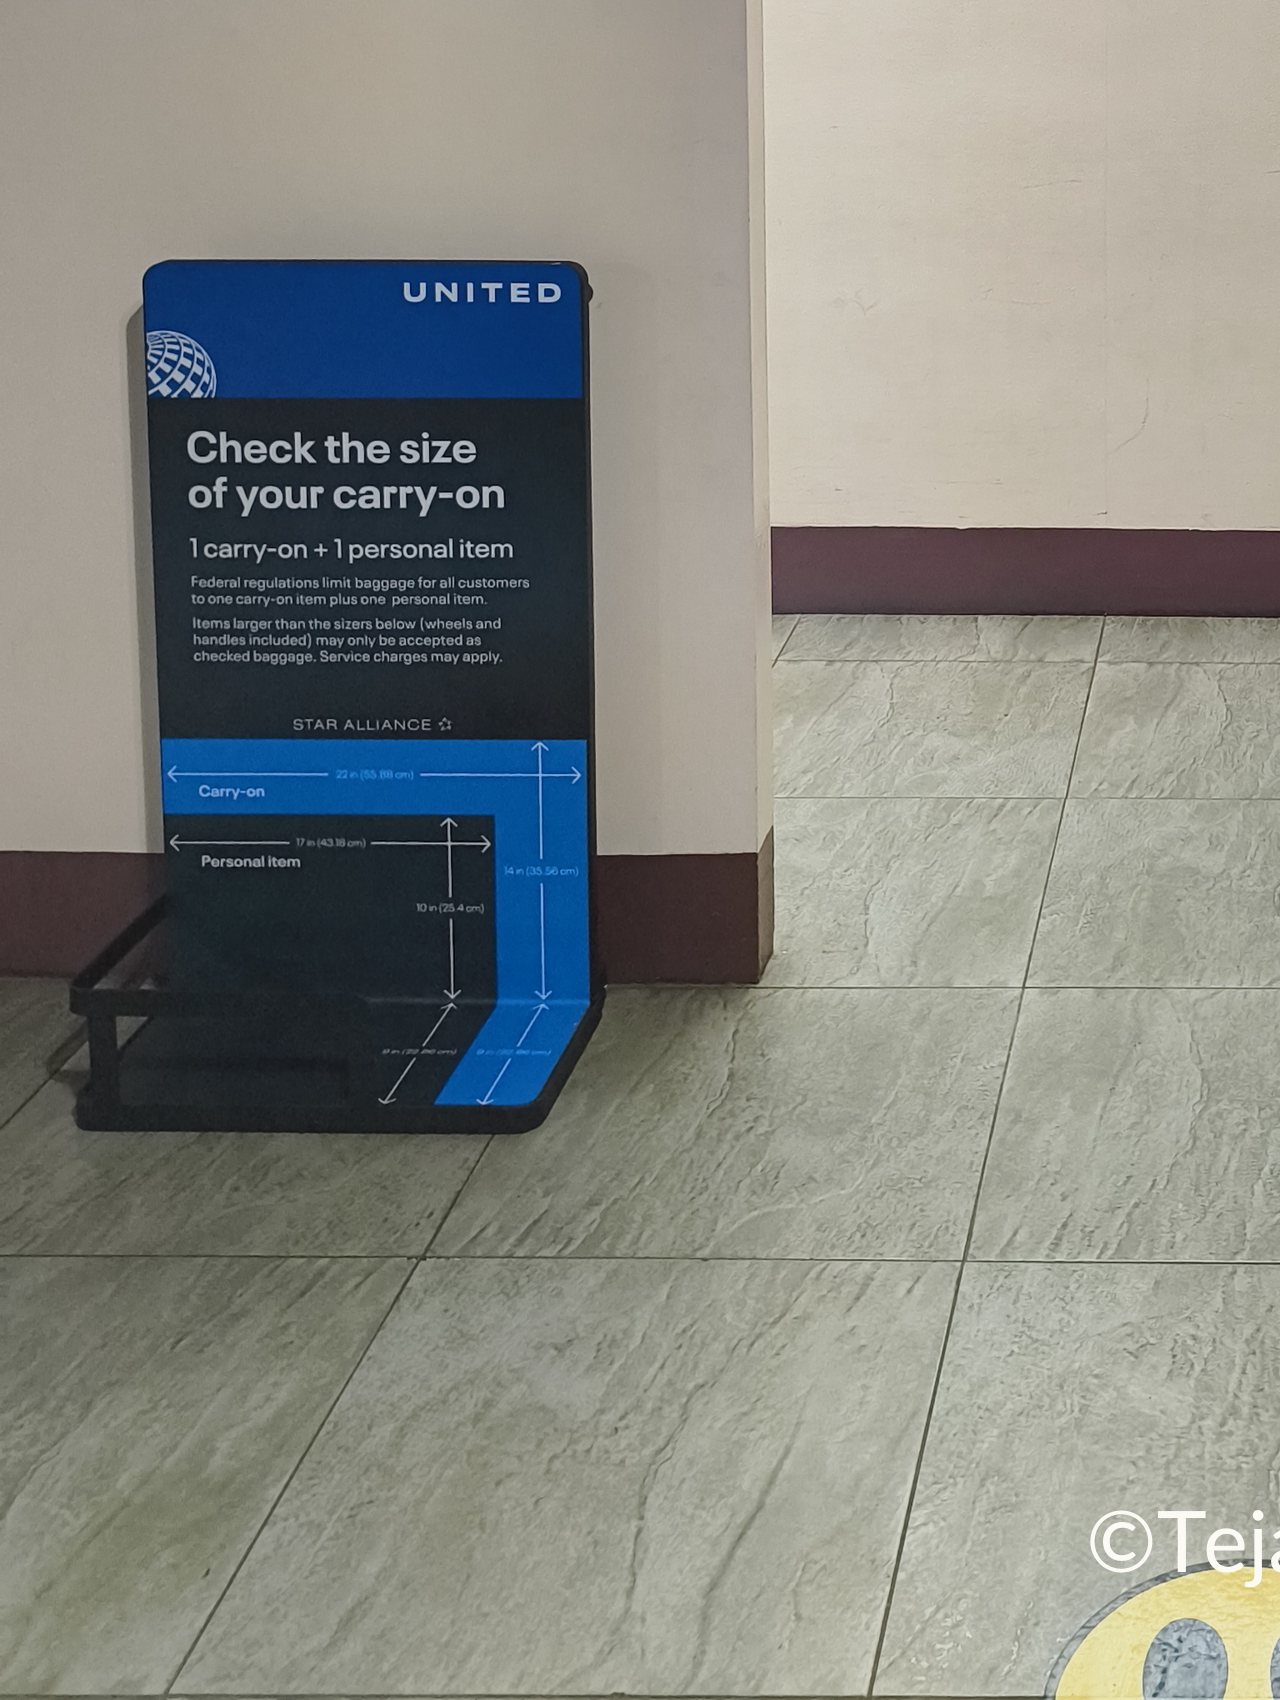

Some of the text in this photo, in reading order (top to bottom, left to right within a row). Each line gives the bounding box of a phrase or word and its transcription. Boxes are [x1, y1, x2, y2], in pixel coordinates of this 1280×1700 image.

[403, 282, 560, 302] UNITED
[187, 430, 476, 463] Check the size
[188, 476, 504, 516] of your carry-on
[189, 537, 512, 563] 1 carry-on + 1 personal item
[191, 575, 529, 591] Federal regulations limit baggage for all customers
[191, 592, 486, 607] to one carry-on item plus one personal item.
[192, 616, 501, 632] Items larger than the sizers below (wheels and
[193, 633, 481, 648] handles included) may only be accepted as
[193, 649, 502, 665] checked baggage. Service charges may apply.
[293, 718, 430, 730] STAR ALLIANCE
[198, 784, 264, 799] Carry-on
[201, 855, 300, 867] Personal item
